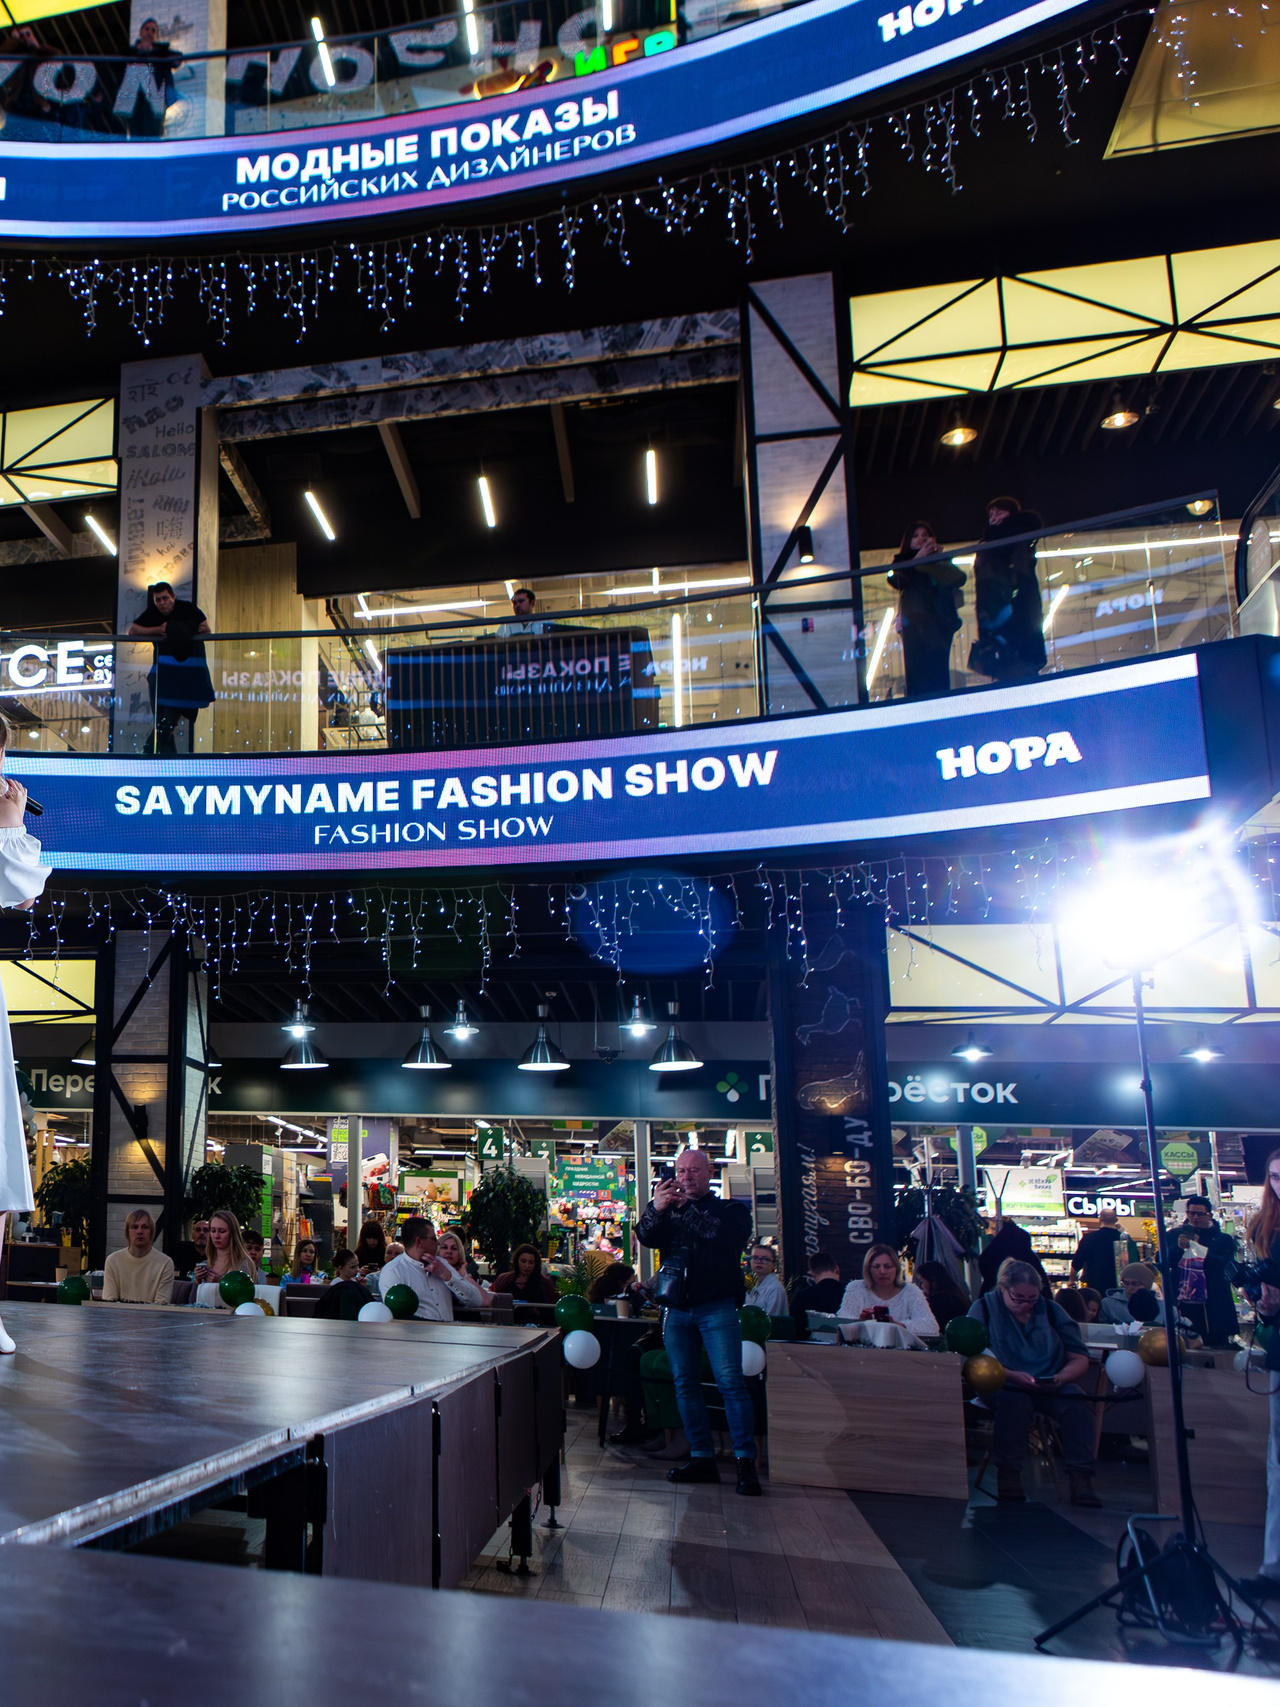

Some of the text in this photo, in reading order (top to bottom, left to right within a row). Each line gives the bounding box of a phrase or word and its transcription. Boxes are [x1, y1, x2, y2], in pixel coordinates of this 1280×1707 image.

[878, 0, 984, 43] НО
[236, 90, 620, 184] МОДНЫЕ ПОКАЗЫ
[222, 123, 637, 212] РОССИЙСКИХ ДИЗАЙНЕРОВ
[155, 422, 194, 438] Hello
[115, 750, 778, 815] SAYMYNAME FASHION SHOW
[314, 815, 554, 845] FASHION SHOW
[482, 1138, 498, 1157] 4
[1163, 1150, 1195, 1158] КАССЫ
[844, 1115, 874, 1245] СВО-БО-ДУ
[1068, 1196, 1135, 1217] СЫРЫ
